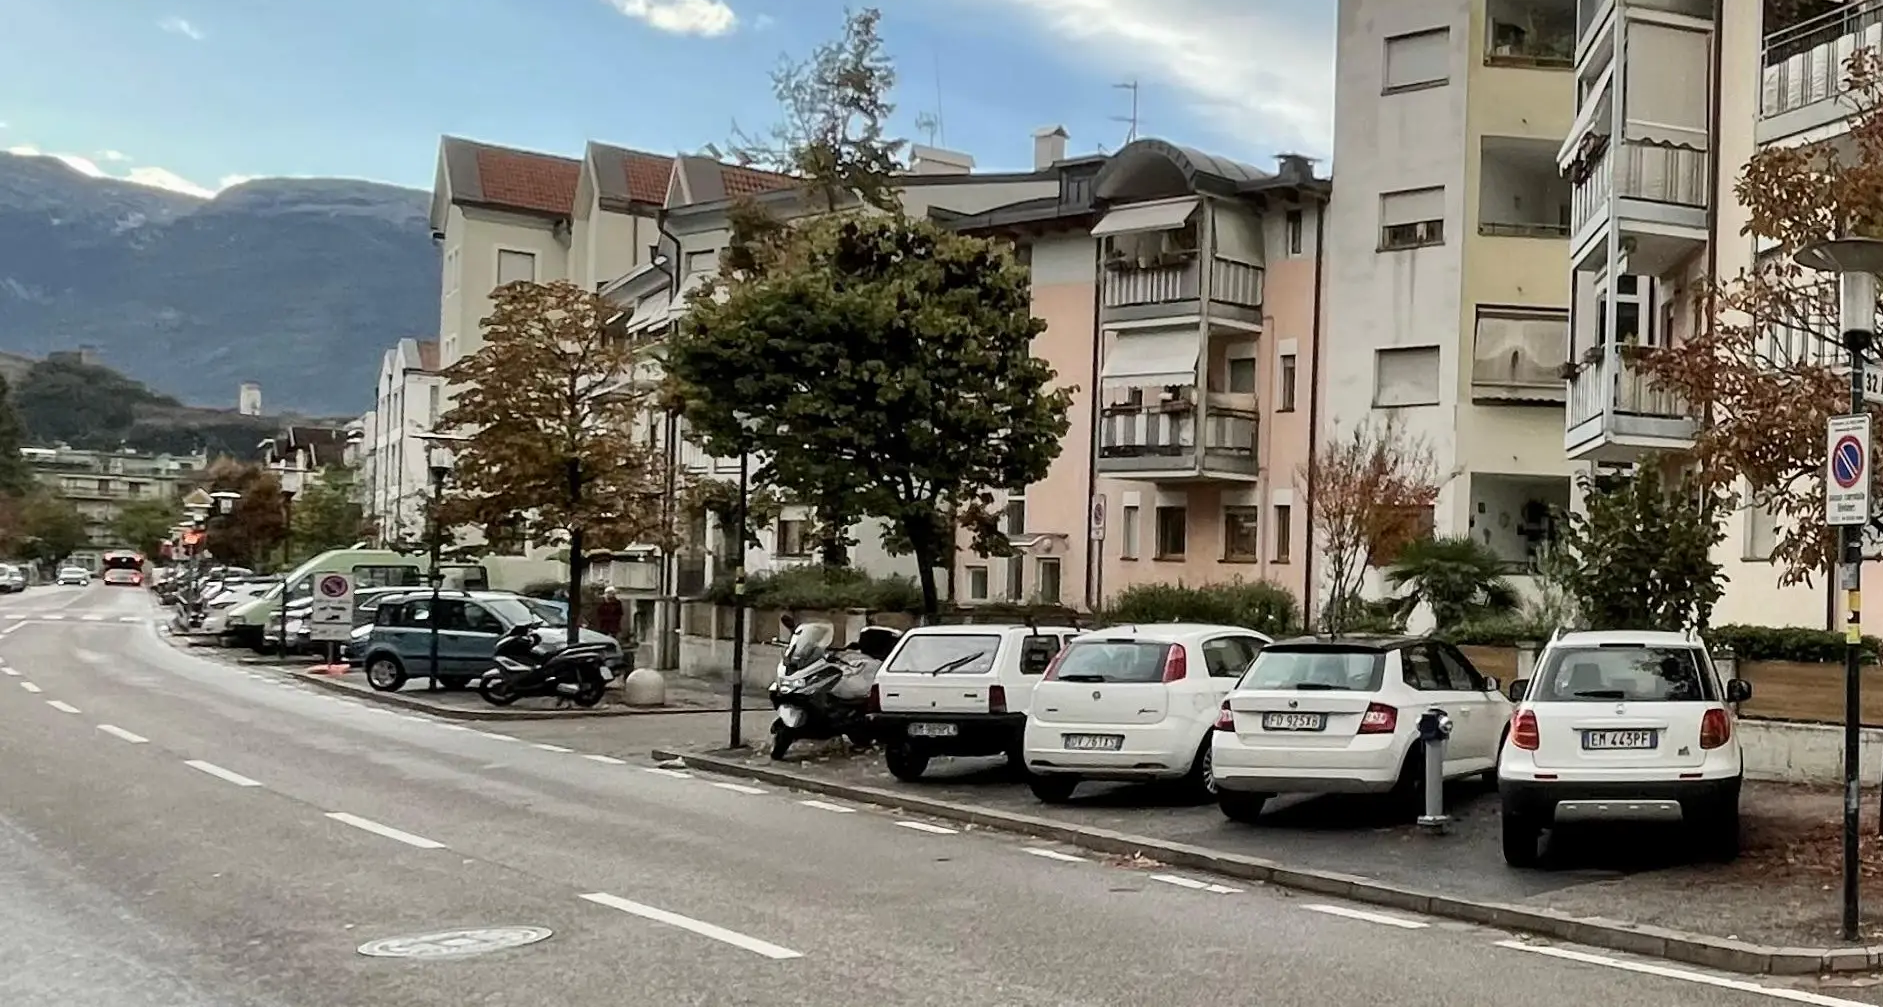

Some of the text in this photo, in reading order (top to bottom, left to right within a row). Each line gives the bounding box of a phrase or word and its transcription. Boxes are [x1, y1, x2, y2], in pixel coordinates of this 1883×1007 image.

[1866, 372, 1878, 393] 32
[1591, 733, 1649, 746] EM 443PF
